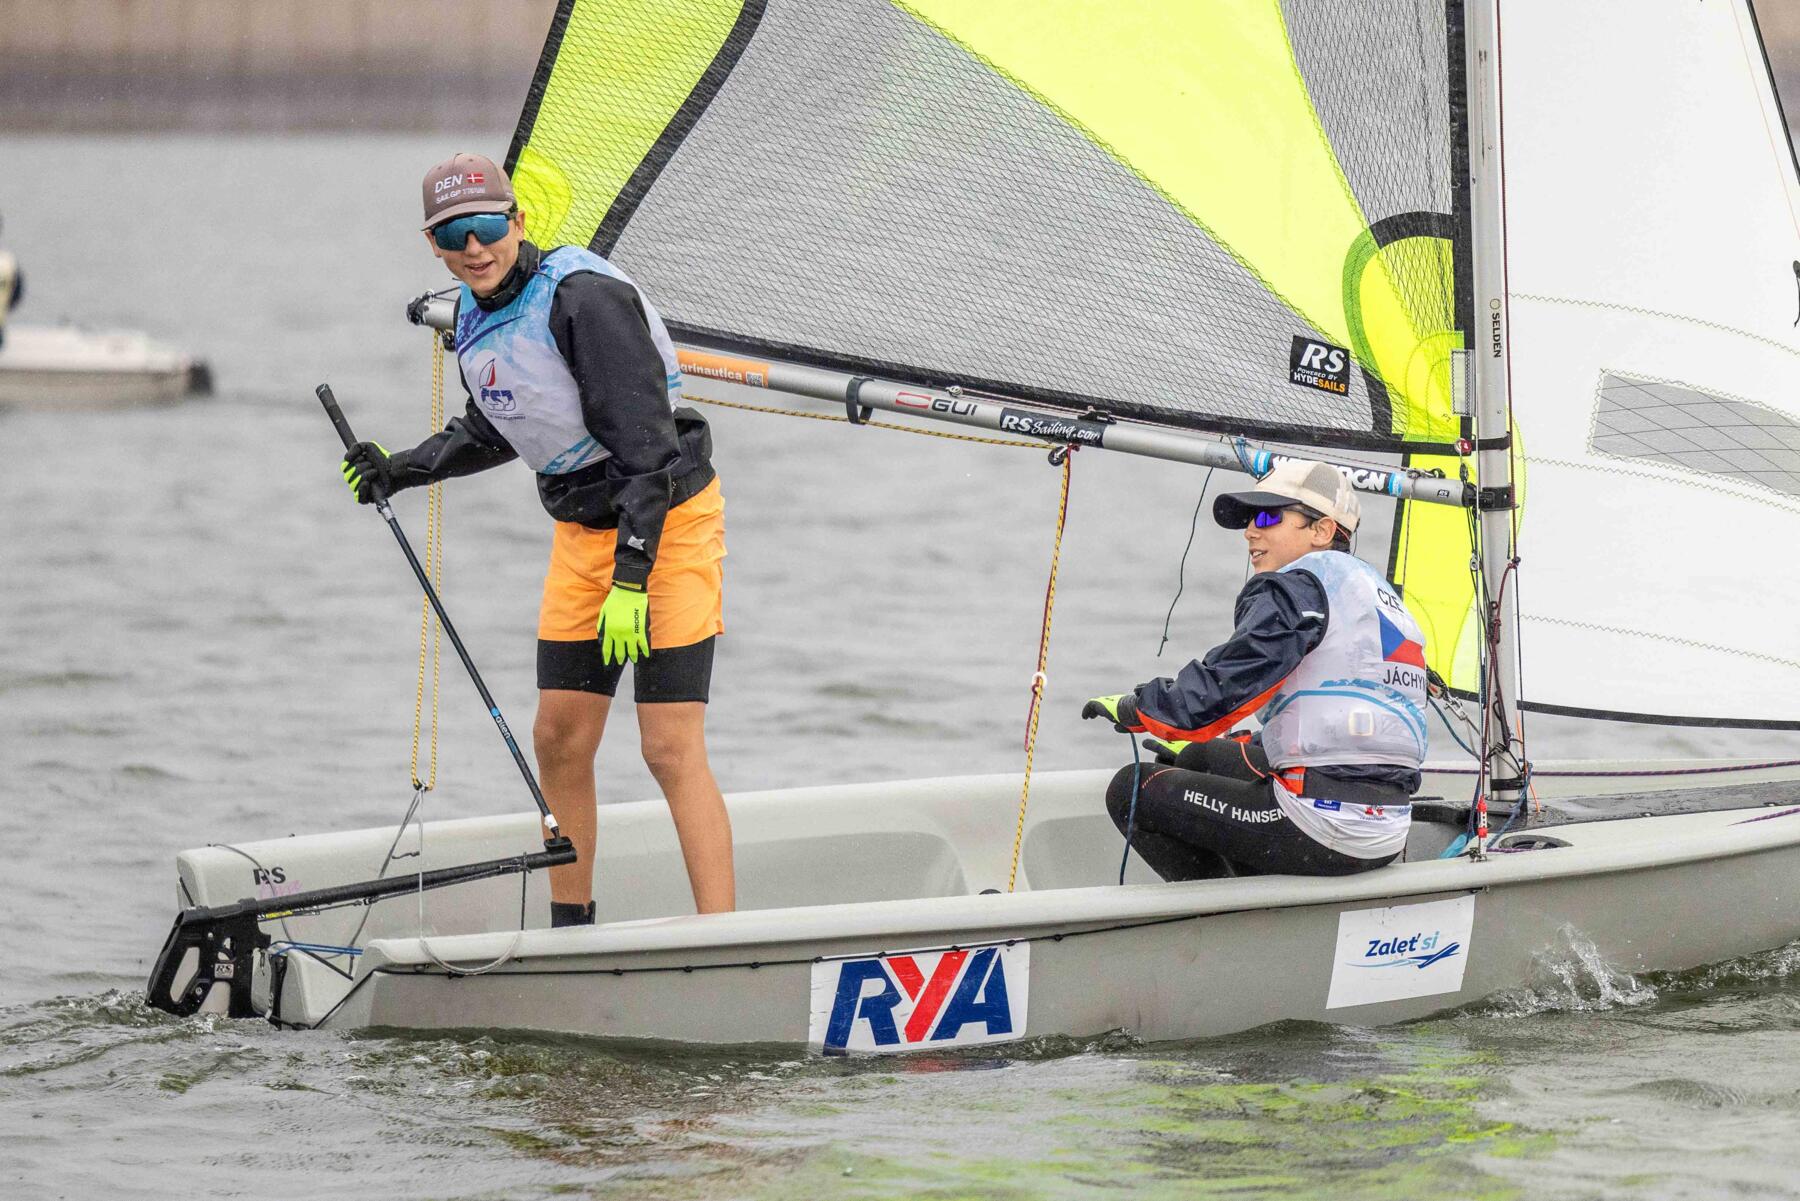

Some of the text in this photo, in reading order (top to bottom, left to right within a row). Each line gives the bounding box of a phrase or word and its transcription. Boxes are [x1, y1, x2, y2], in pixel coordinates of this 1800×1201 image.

[434, 173, 463, 194] DEN
[1300, 343, 1345, 373] RS
[1297, 366, 1327, 378] POWERED
[1183, 789, 1287, 824] HELLY HANSEN
[253, 866, 286, 886] RS
[1421, 931, 1440, 951] si
[822, 947, 1013, 1056] RYA
